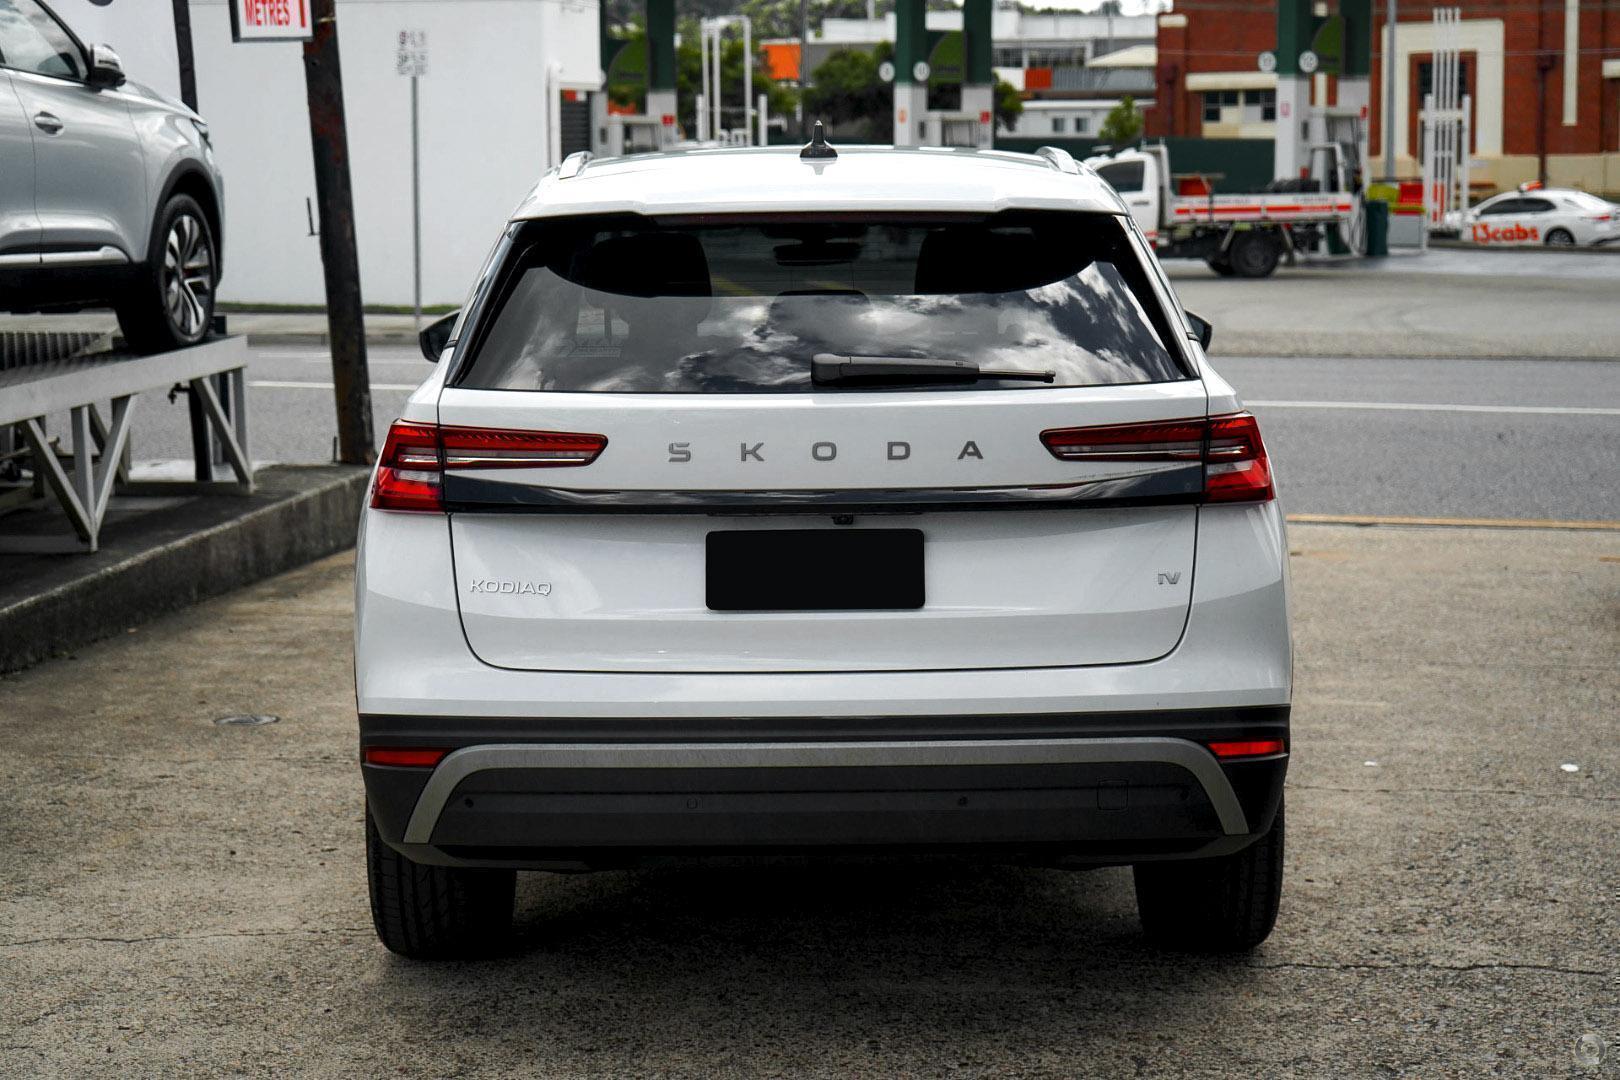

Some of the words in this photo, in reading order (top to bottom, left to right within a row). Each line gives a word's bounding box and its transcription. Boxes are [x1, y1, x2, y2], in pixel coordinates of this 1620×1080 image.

[244, 0, 290, 26] METRES
[668, 440, 984, 463] SKODA
[470, 579, 552, 596] KODIAQ
